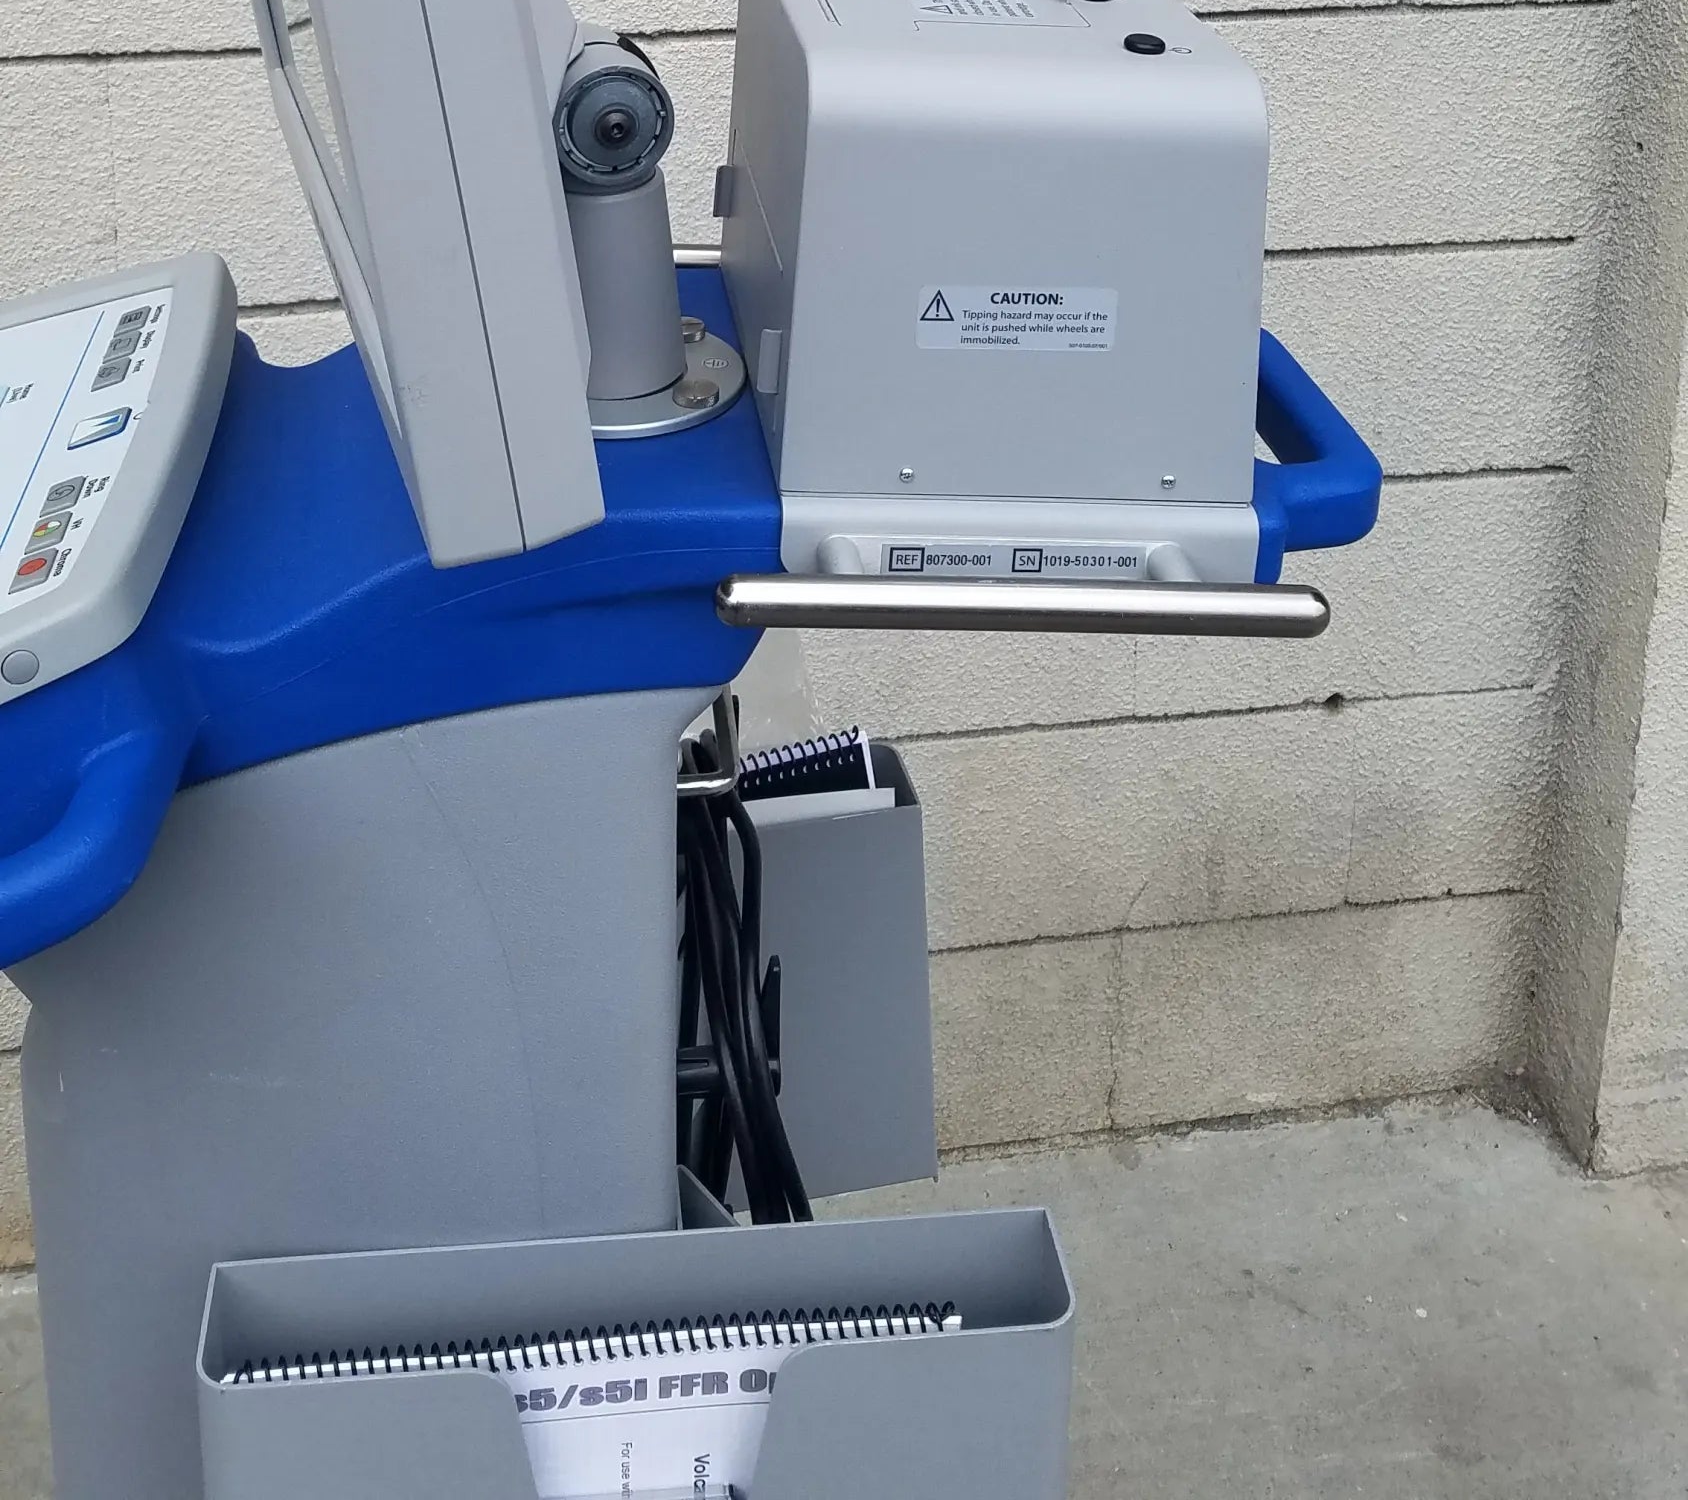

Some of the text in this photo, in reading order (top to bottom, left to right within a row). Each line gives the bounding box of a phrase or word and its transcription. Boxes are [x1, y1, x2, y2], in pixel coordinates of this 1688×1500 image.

[990, 292, 1064, 306] CAUTION:
[962, 310, 1108, 322] Tipping hazard may occur if the
[961, 323, 1105, 334] unit is pushed while wheels are
[960, 336, 1021, 346] immobilized.
[83, 479, 98, 499] Down
[94, 476, 110, 493] Ring
[71, 518, 84, 530] VH
[53, 549, 72, 577] Chroma
[895, 554, 992, 566] REF 807300-001
[1018, 555, 1138, 568] SN 1019-50301-001
[659, 1371, 729, 1399] FFR
[621, 1442, 633, 1458] For
[621, 1461, 630, 1479] use
